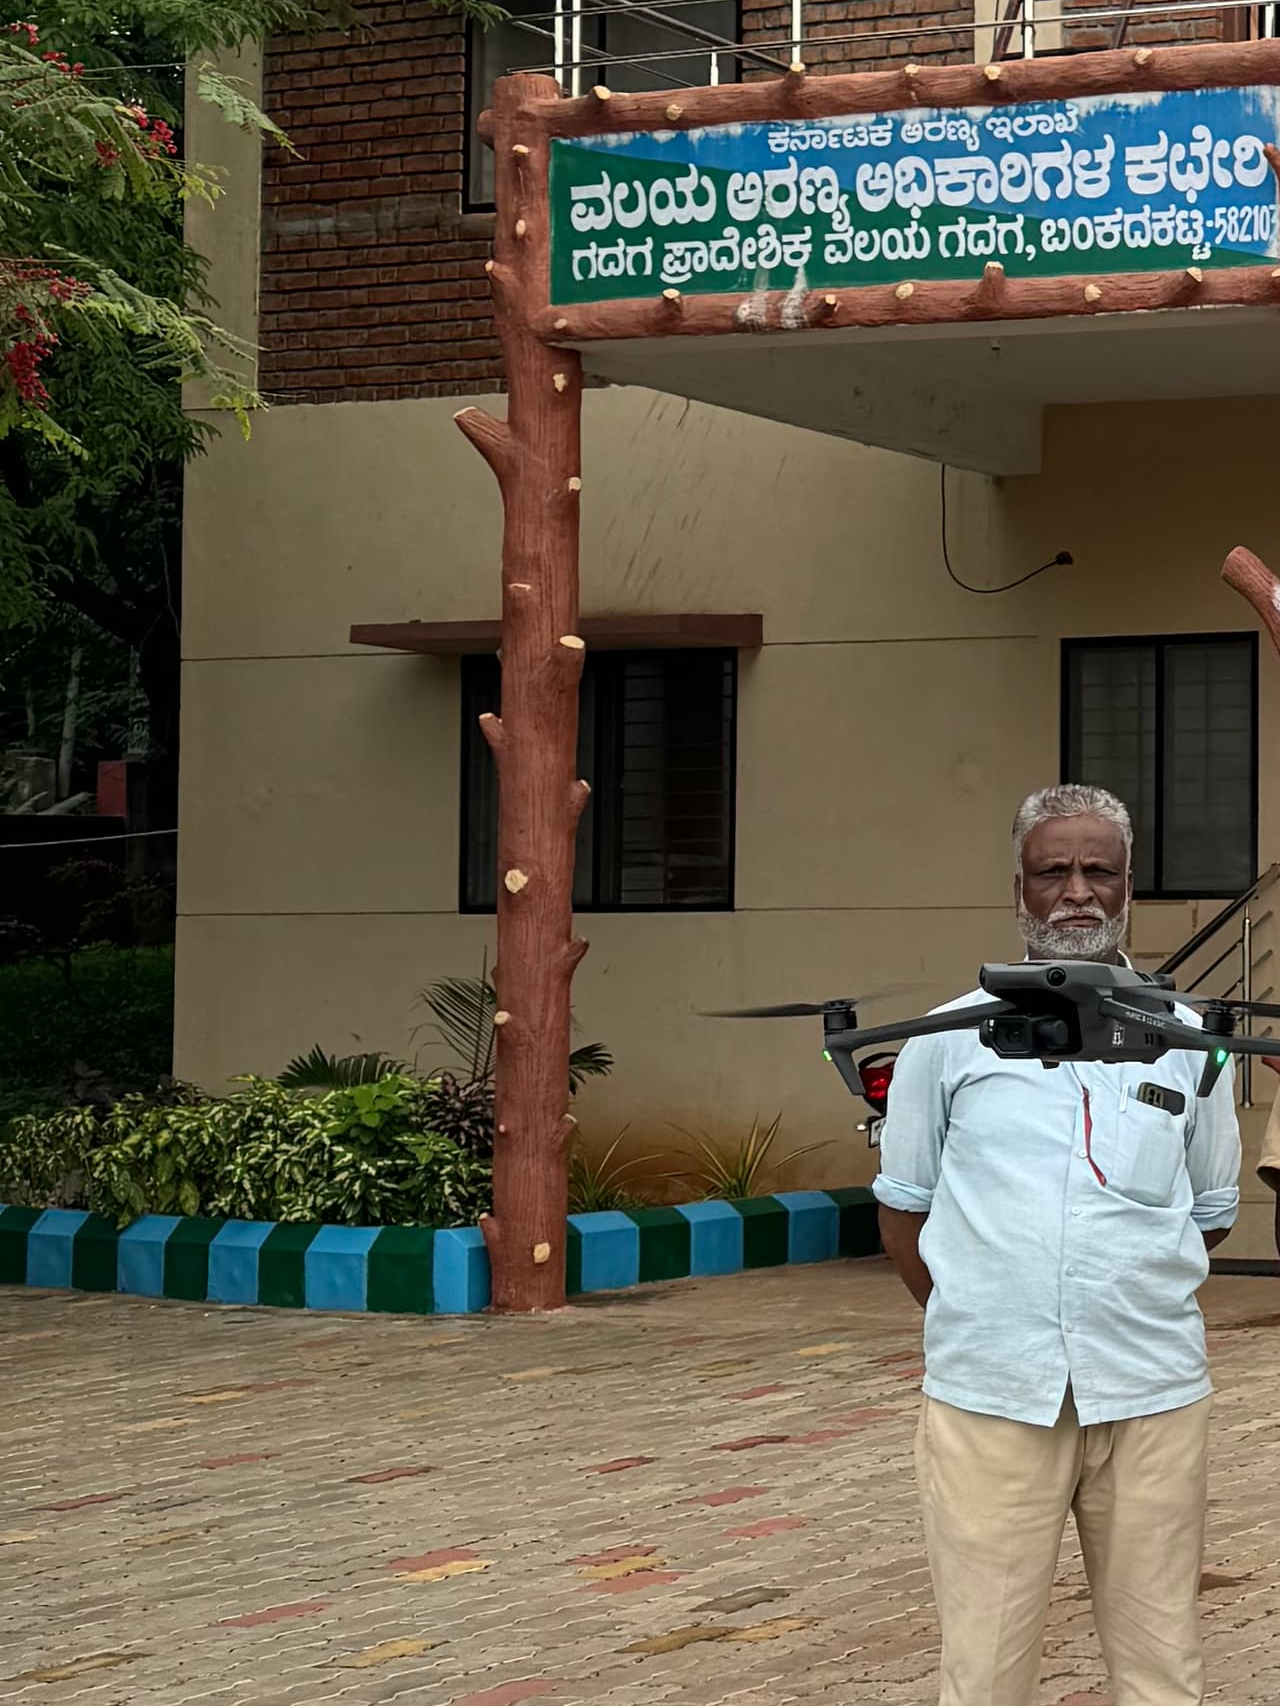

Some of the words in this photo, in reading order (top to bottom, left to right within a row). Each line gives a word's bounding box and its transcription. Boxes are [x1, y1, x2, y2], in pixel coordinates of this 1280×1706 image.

[900, 116, 981, 152] ಅರಣ್ಯ
[984, 102, 1080, 144] ಇಲಾಖೆ
[569, 162, 718, 233] ವಲಯ
[725, 154, 852, 233] ಅರಣ್ಯ
[855, 132, 1117, 220] ಅಧಿಕಾರಿಗಳ
[1124, 124, 1270, 205] ಕಛೇರಿ
[570, 236, 654, 282] ಗದಗ
[658, 223, 815, 284] ಪ್ರಾದೇಶಿಕ
[823, 220, 932, 265] ವಲಯ
